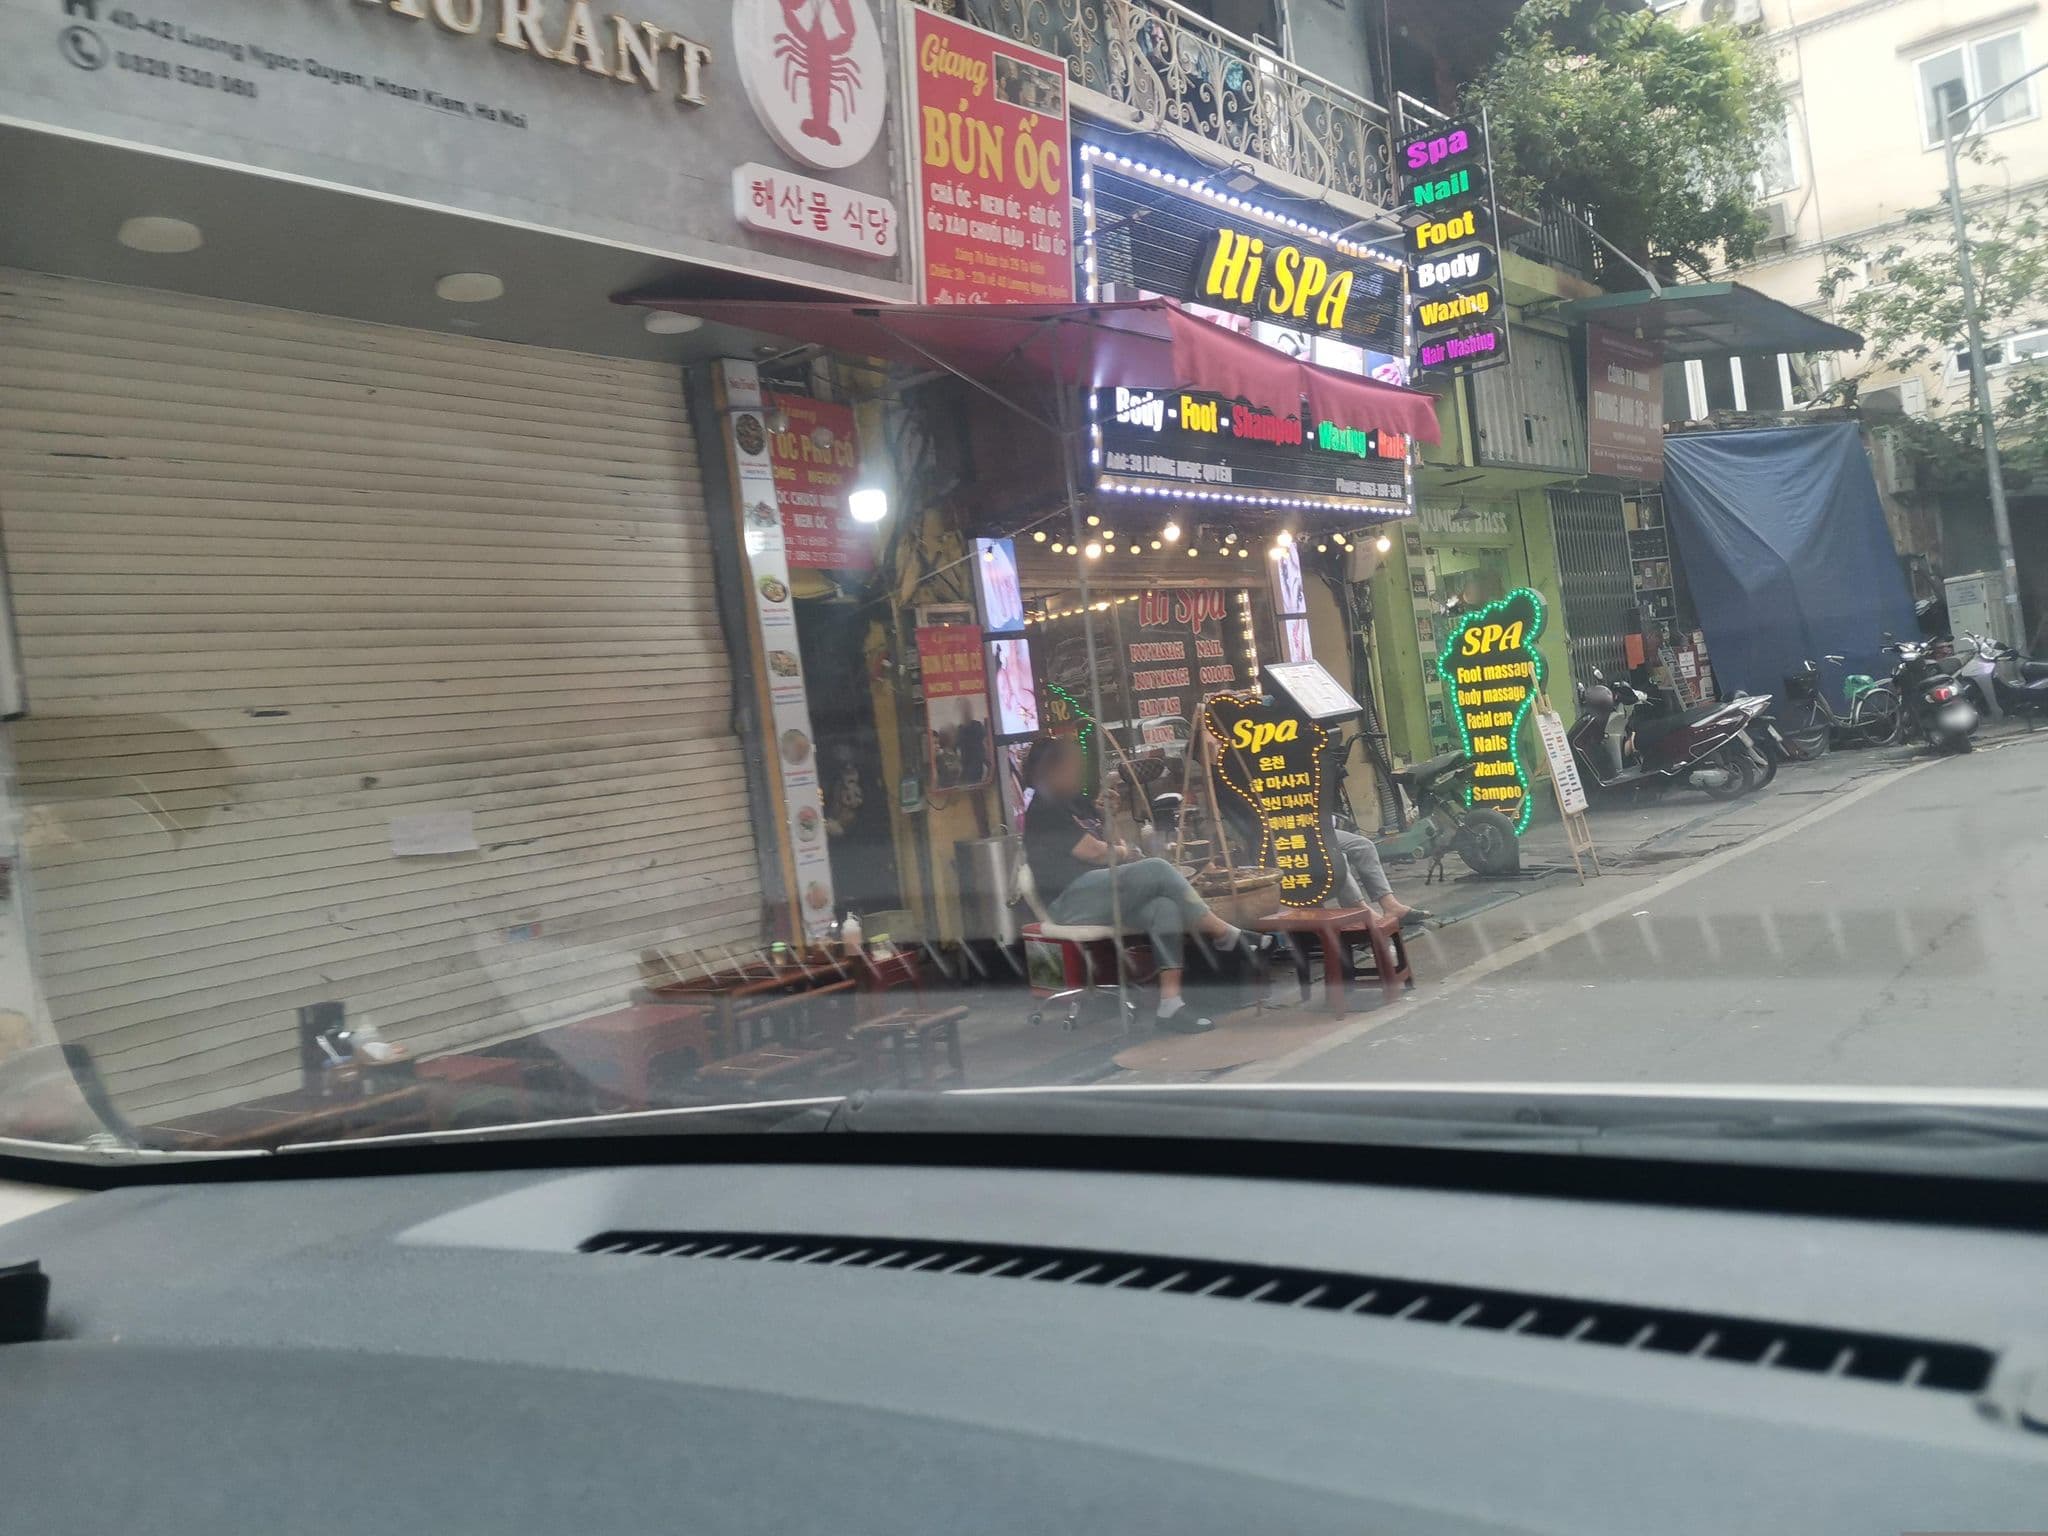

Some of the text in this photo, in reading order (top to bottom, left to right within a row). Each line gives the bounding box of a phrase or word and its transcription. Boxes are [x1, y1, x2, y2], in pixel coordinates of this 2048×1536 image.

[248, 44, 301, 71] Ngoc
[920, 33, 988, 96] Giang
[922, 98, 1061, 195] BÚN ỐC
[1407, 130, 1469, 169] Spa
[1413, 169, 1470, 208] Nail
[752, 177, 889, 245] 해산물 식당
[1416, 210, 1475, 249] Foot
[1206, 229, 1354, 329] Hi SPA
[1417, 252, 1480, 288] Body
[1419, 291, 1489, 326] Waxing
[1421, 332, 1496, 366] Hair Washing
[1116, 386, 1164, 432] Body
[1181, 395, 1218, 433] Foot
[1232, 404, 1302, 446] Shampoo
[1318, 420, 1367, 459] Waxing
[1175, 589, 1228, 634] Spa
[1462, 620, 1523, 656] SPA
[1200, 665, 1235, 684] COLOUR
[1457, 667, 1483, 684] Foot
[1458, 685, 1526, 706] Body massage
[1232, 719, 1298, 753] Spa
[1467, 711, 1513, 729] Facial care
[1474, 737, 1508, 753] Nails
[1266, 772, 1310, 790] 마사지
[1474, 761, 1515, 777] Waxing
[1473, 785, 1522, 801] Sampoo
[1277, 854, 1309, 869] 왁싱
